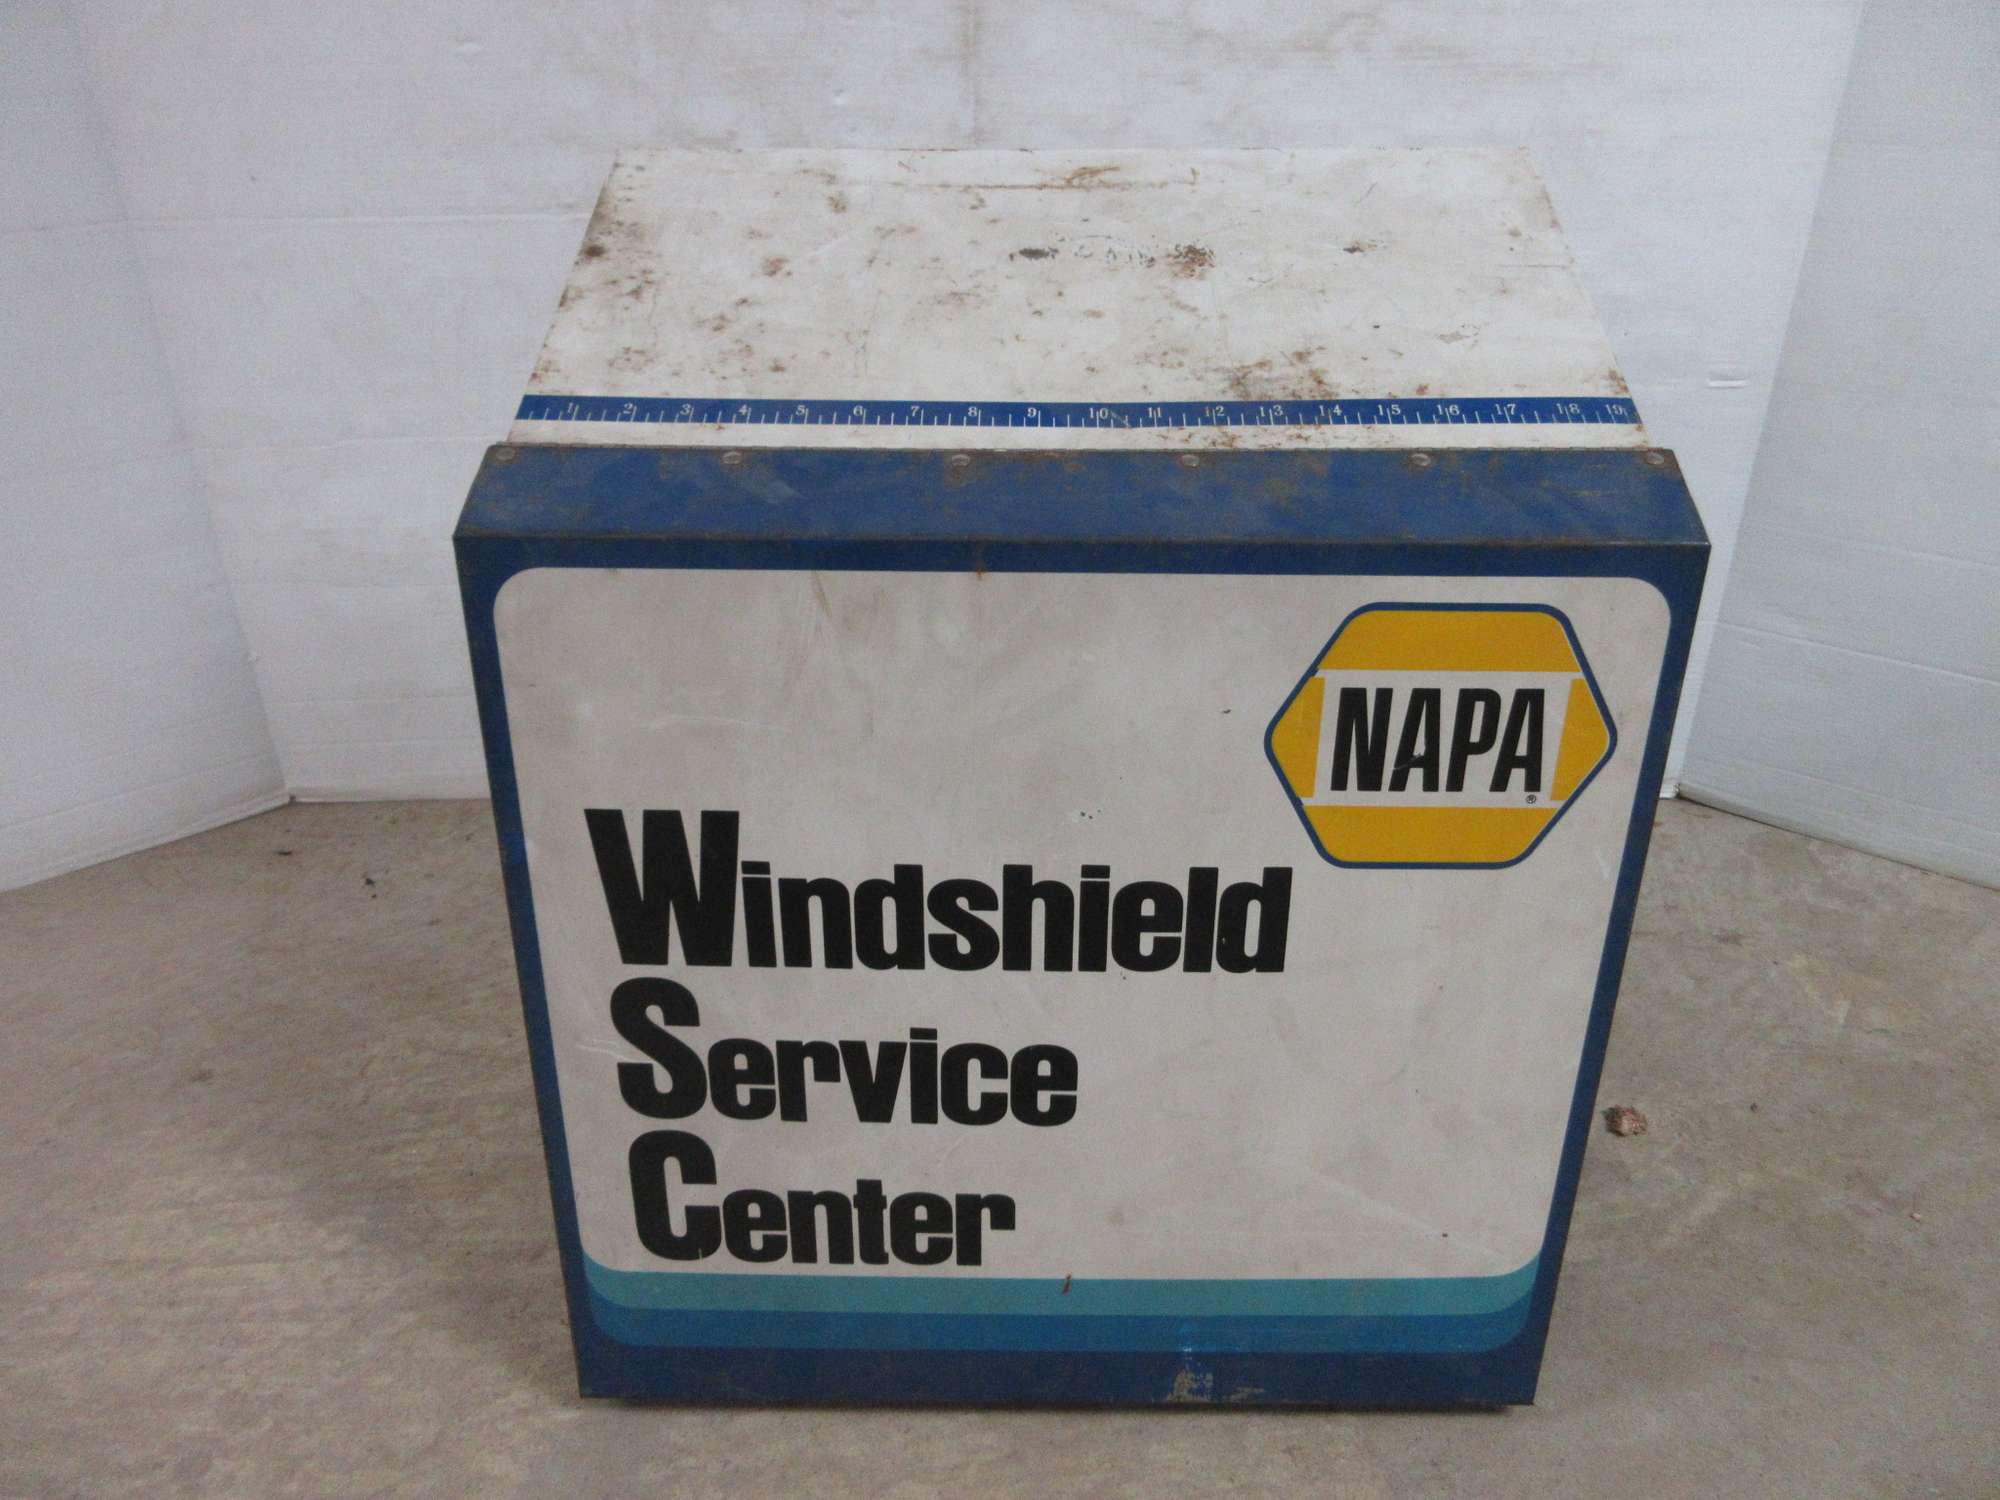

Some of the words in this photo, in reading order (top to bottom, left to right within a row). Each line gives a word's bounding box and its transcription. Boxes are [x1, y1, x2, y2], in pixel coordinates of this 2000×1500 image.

[567, 402, 574, 414] 1
[623, 403, 633, 414] 2
[680, 403, 690, 415] 3
[738, 404, 748, 415] 4
[796, 405, 805, 416] 5
[853, 405, 863, 416] 6
[910, 406, 920, 417] 7
[967, 406, 978, 417] 8
[1027, 407, 1037, 417] 9
[1088, 407, 1109, 419] 10
[1148, 407, 1163, 418] 11
[1204, 405, 1226, 417] 12
[1259, 405, 1284, 417] 13
[1318, 404, 1343, 416] 14
[1377, 404, 1401, 416] 15
[1436, 404, 1460, 416] 16
[1494, 403, 1516, 415] 17
[1556, 403, 1581, 415] 18
[1330, 687, 1545, 793] NAPA
[584, 808, 1293, 974] Windshield
[610, 977, 1078, 1127] Service
[628, 1130, 1017, 1267] Center
